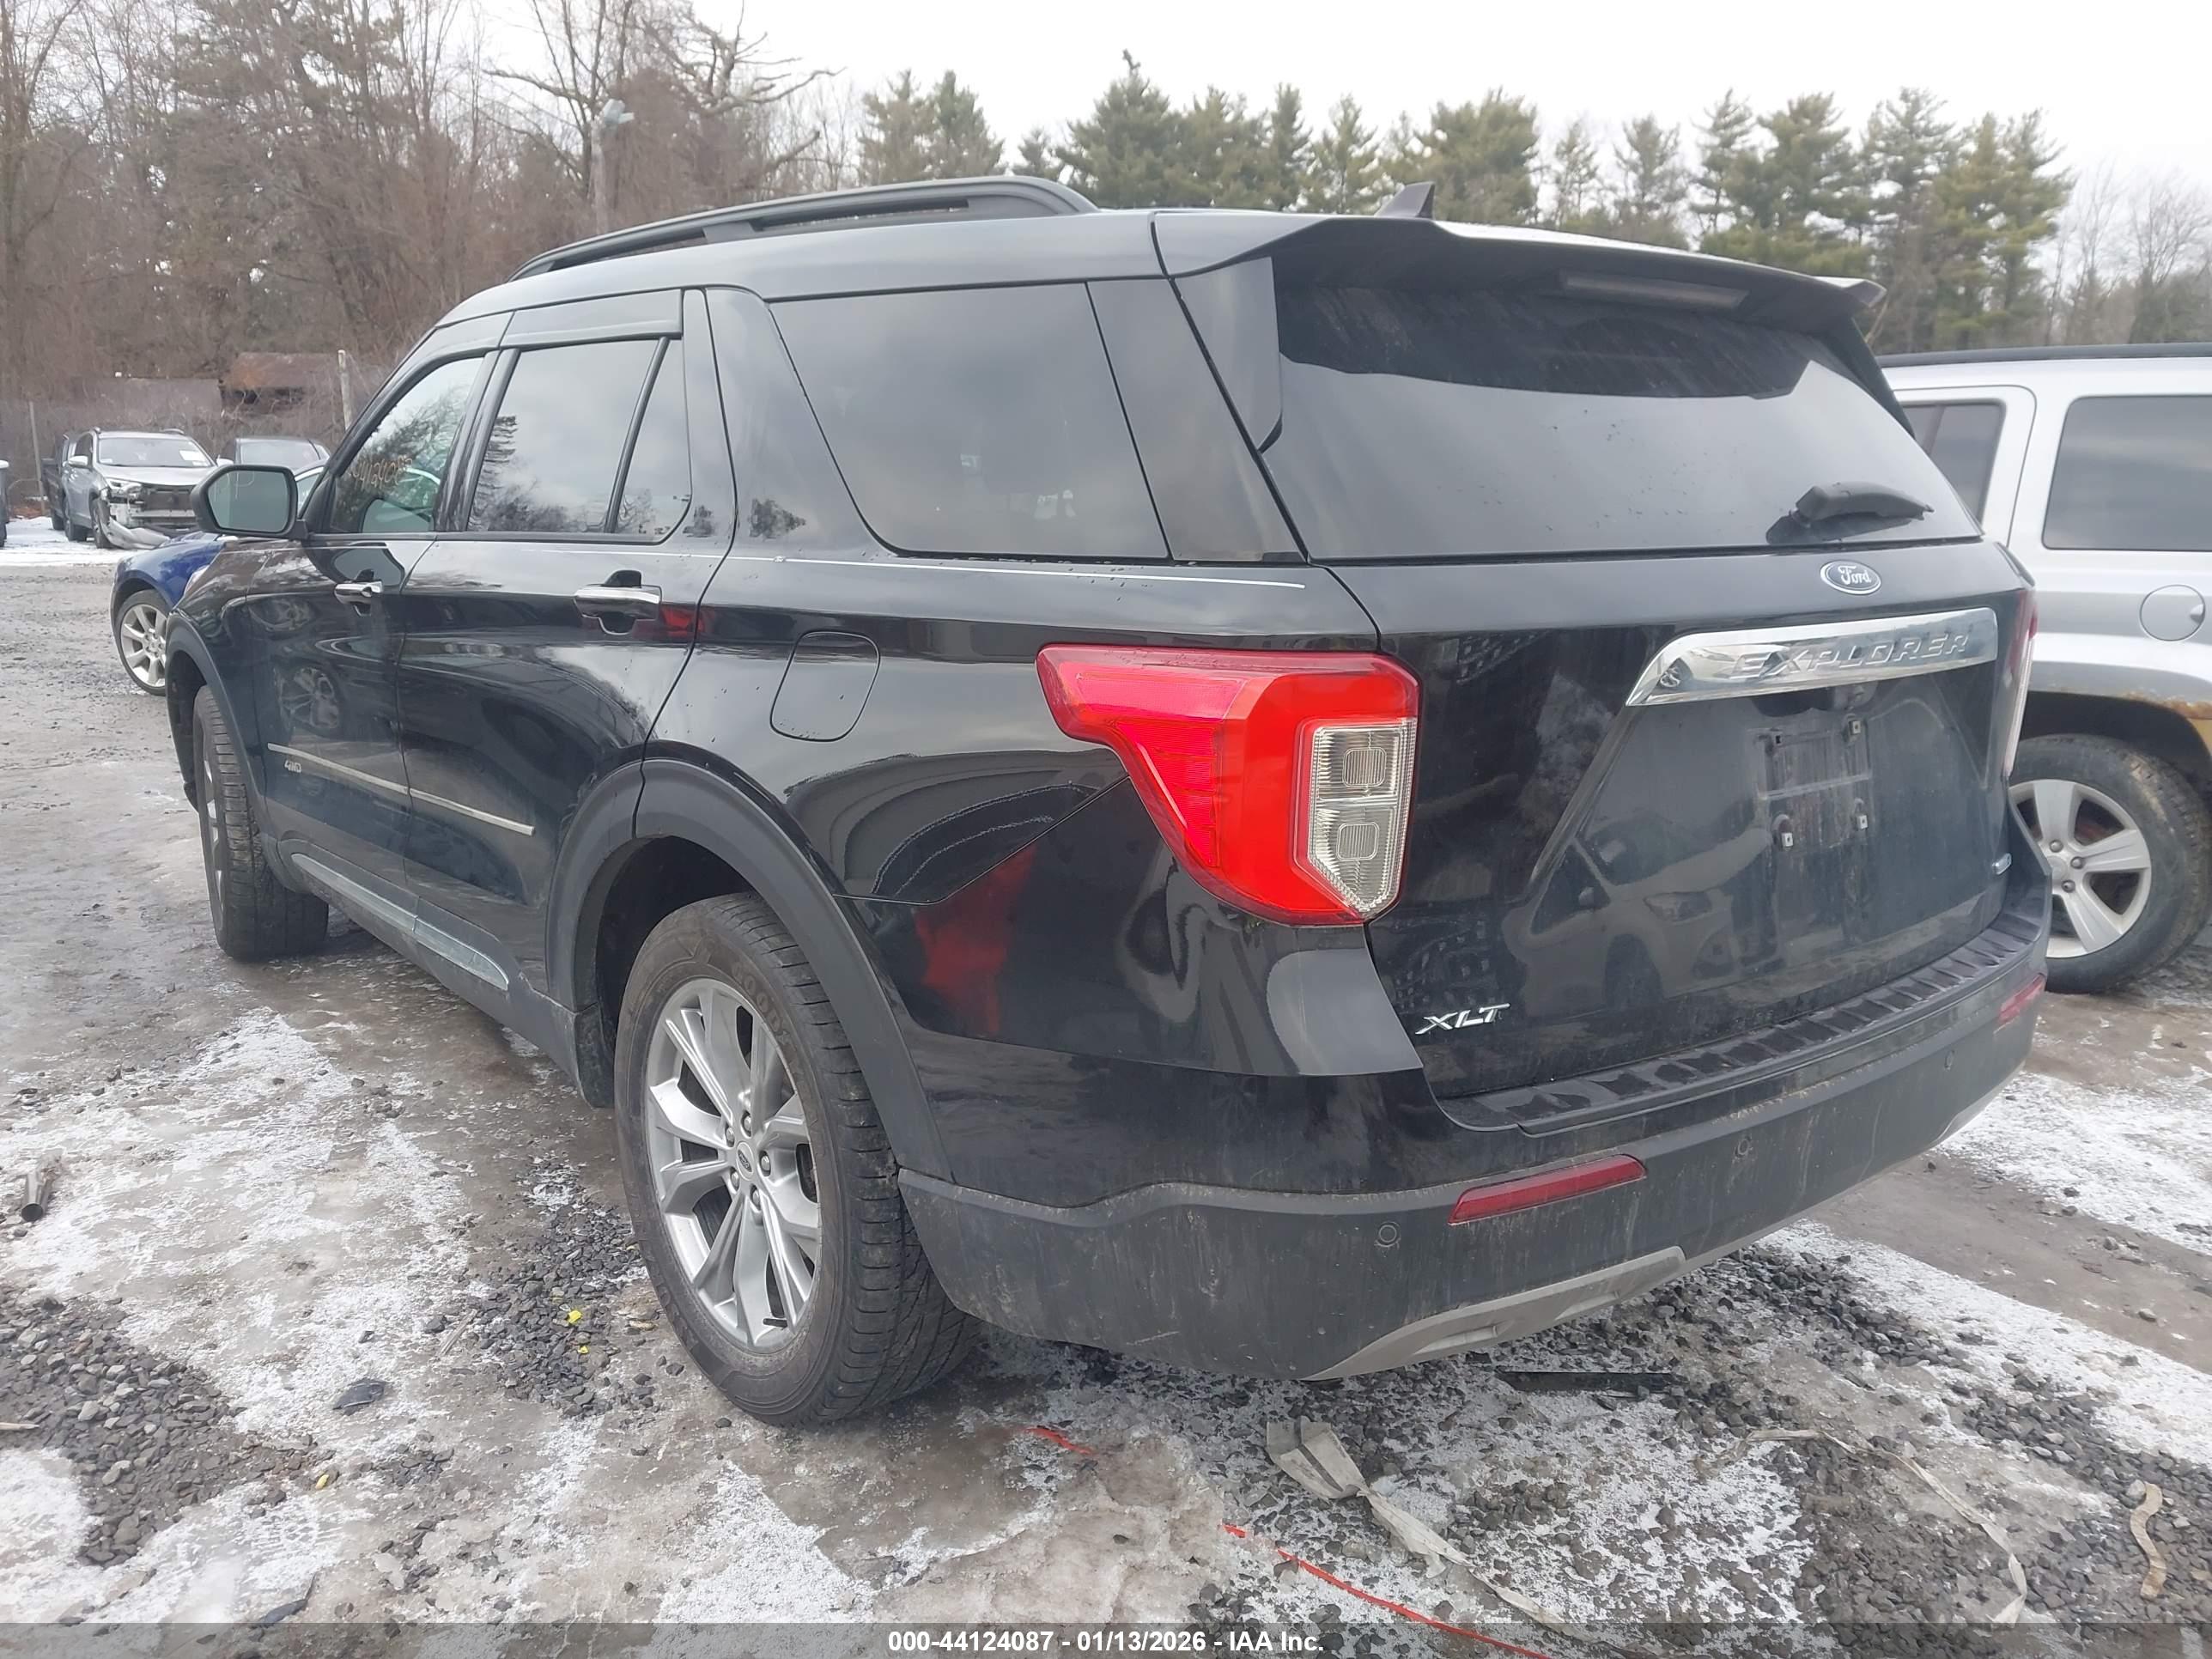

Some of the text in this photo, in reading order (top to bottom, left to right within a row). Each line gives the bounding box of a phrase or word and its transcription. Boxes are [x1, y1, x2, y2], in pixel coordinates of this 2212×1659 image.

[1838, 565, 1872, 585] Ford
[1729, 635, 1969, 680] EXPLORER
[1414, 1002, 1511, 1035] XLT
